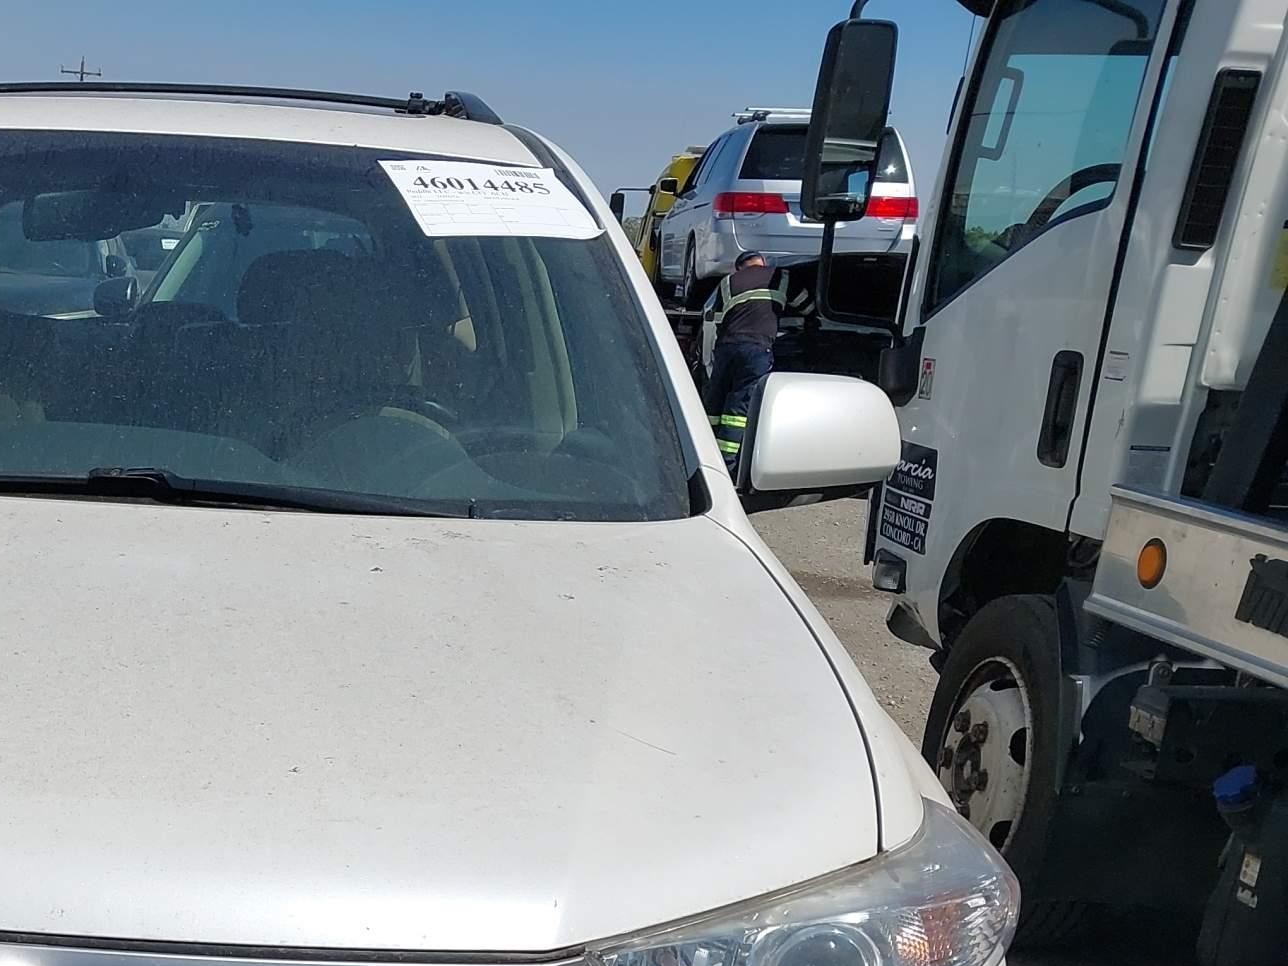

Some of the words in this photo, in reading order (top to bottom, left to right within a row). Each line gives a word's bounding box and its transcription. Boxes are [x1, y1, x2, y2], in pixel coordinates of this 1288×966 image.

[413, 175, 551, 196] 46014485
[888, 458, 934, 481] arcia
[897, 473, 924, 490] TOWING
[900, 496, 926, 516] NRR
